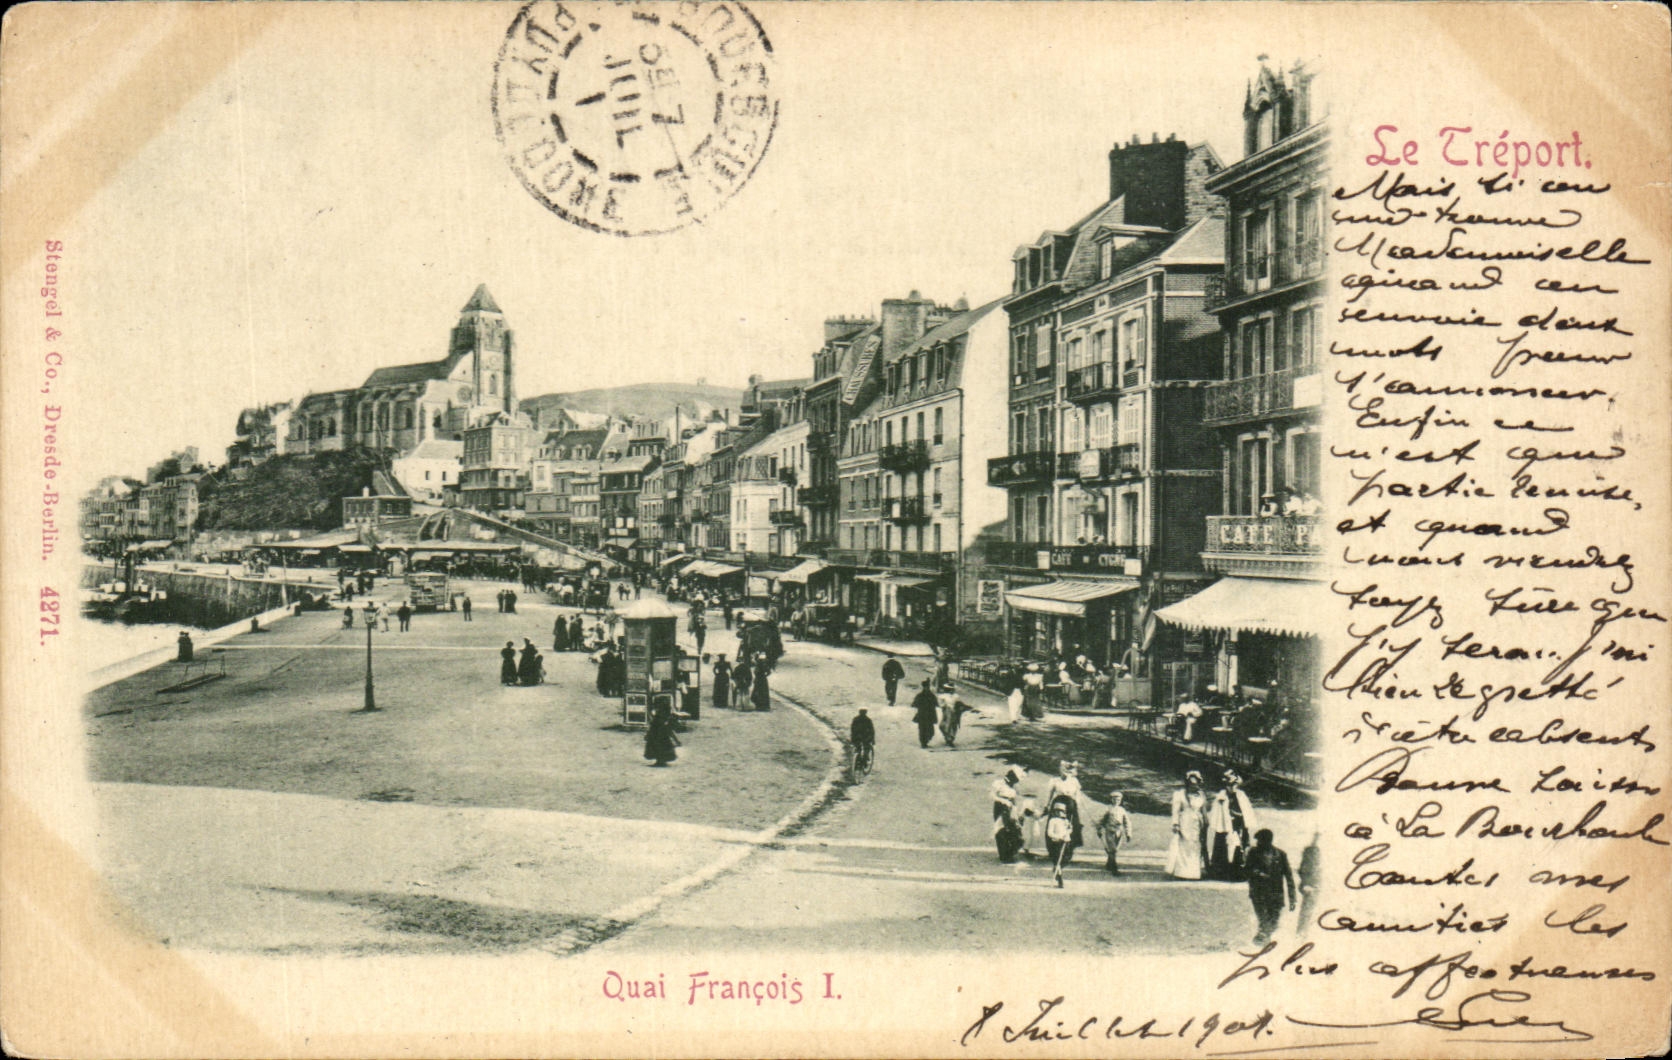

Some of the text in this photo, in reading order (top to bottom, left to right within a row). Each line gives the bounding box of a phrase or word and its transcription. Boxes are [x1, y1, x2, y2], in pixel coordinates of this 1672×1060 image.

[1366, 125, 1592, 179] Le Tréport.
[41, 240, 63, 318] Stengel
[44, 326, 63, 342] &
[41, 351, 63, 394] Co.,
[1349, 394, 1469, 441] Enfin
[1348, 469, 1495, 506] partie
[39, 586, 61, 647] 4271.
[603, 970, 842, 1006] Quai François I.
